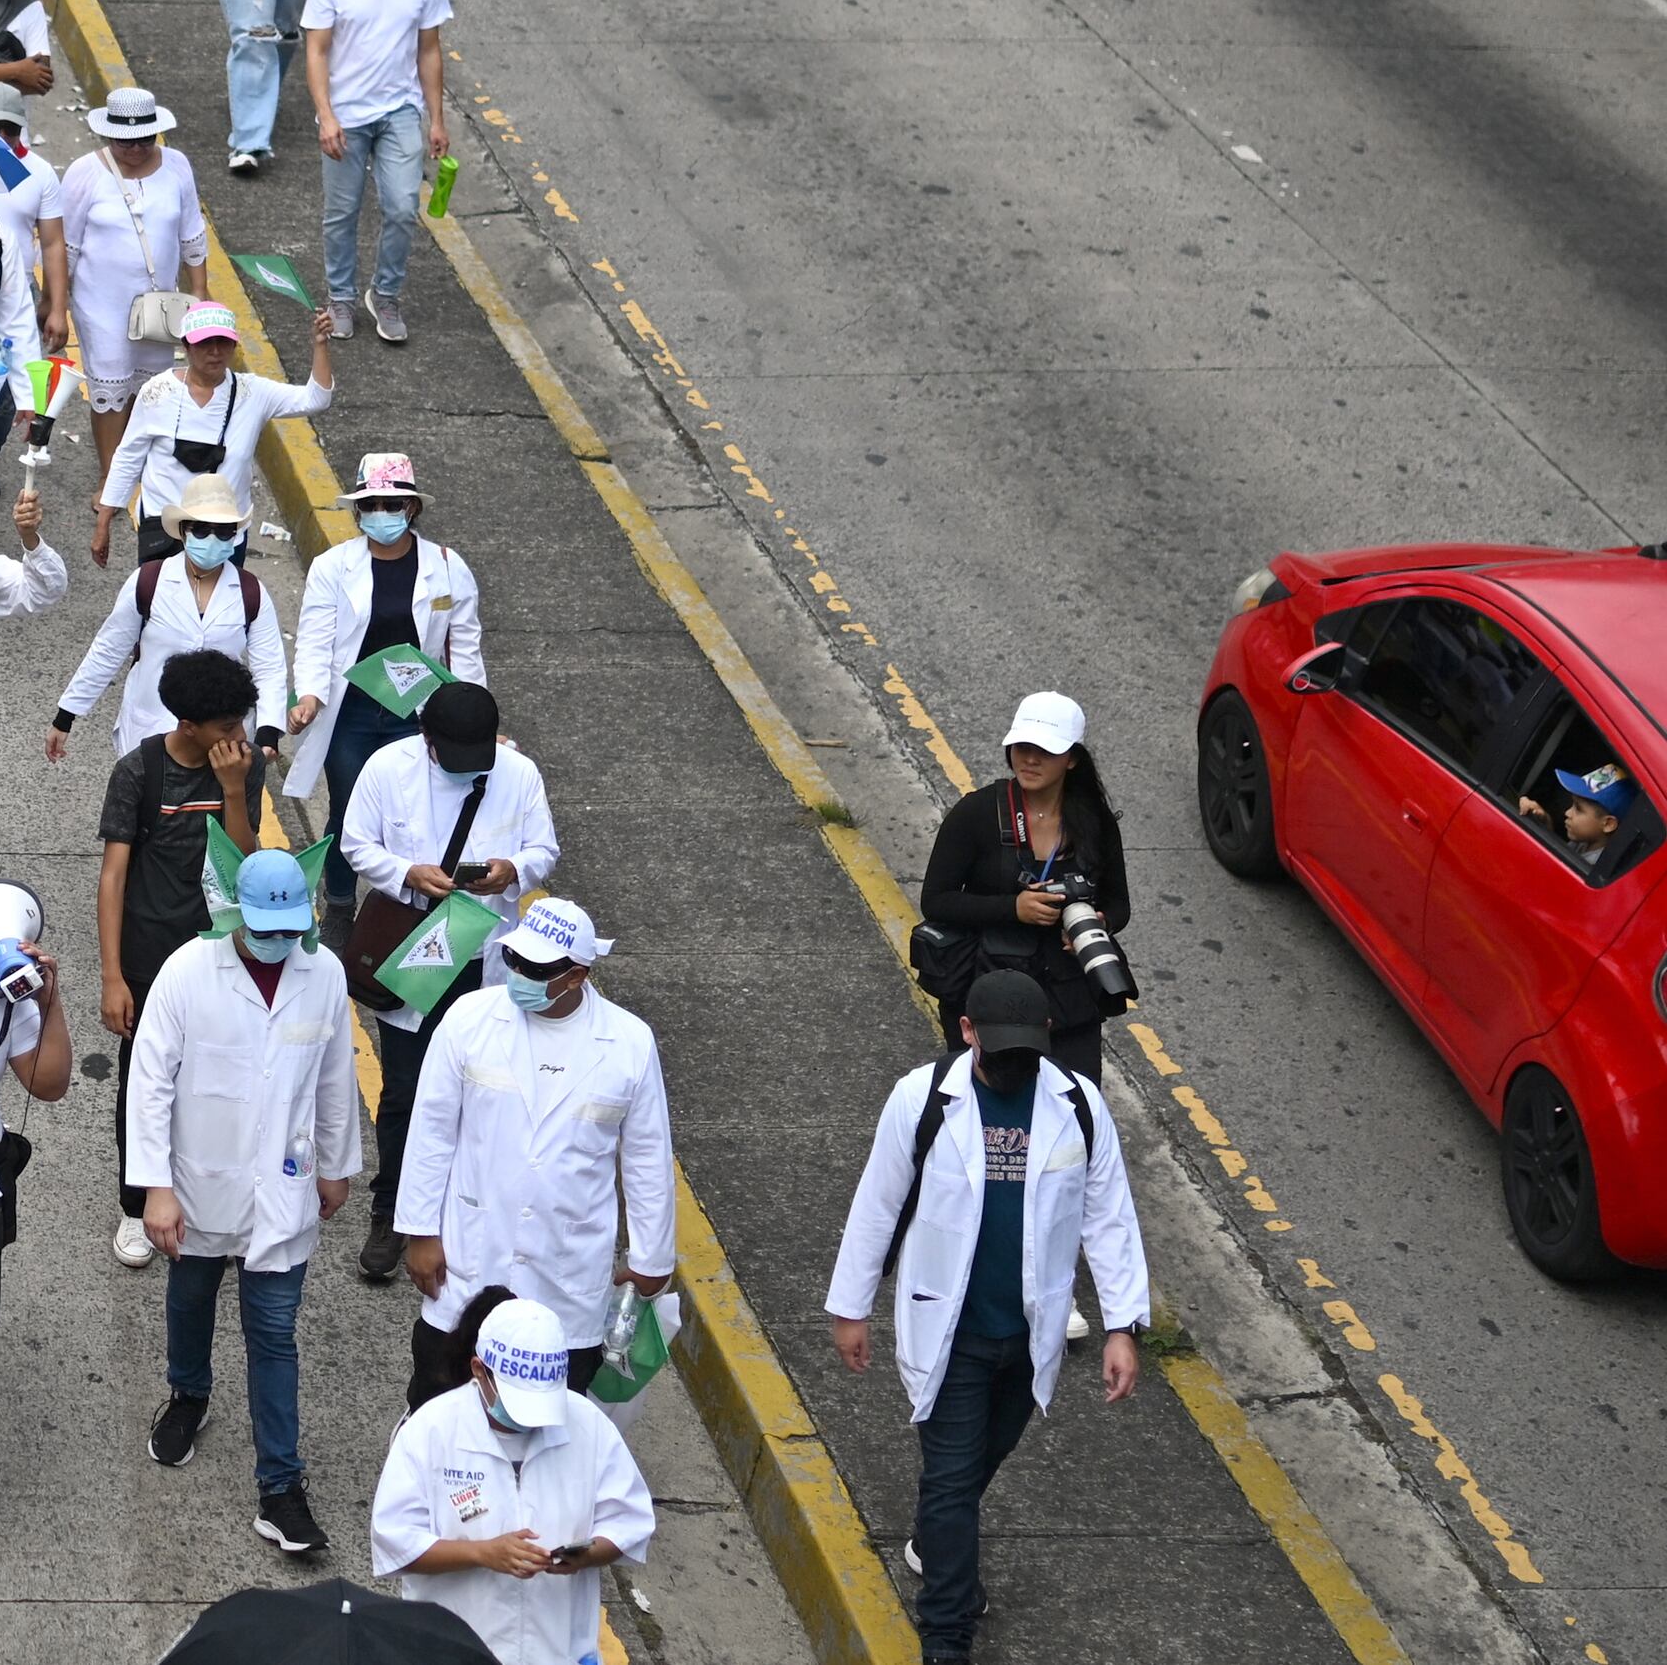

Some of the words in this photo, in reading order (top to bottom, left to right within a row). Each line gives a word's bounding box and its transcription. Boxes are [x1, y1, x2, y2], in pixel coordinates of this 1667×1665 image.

[1017, 812, 1027, 842] Canon
[483, 1350, 497, 1369] MI
[492, 1338, 507, 1354] YO
[511, 1347, 566, 1363] DEFIEND
[466, 1471, 485, 1480] AID
